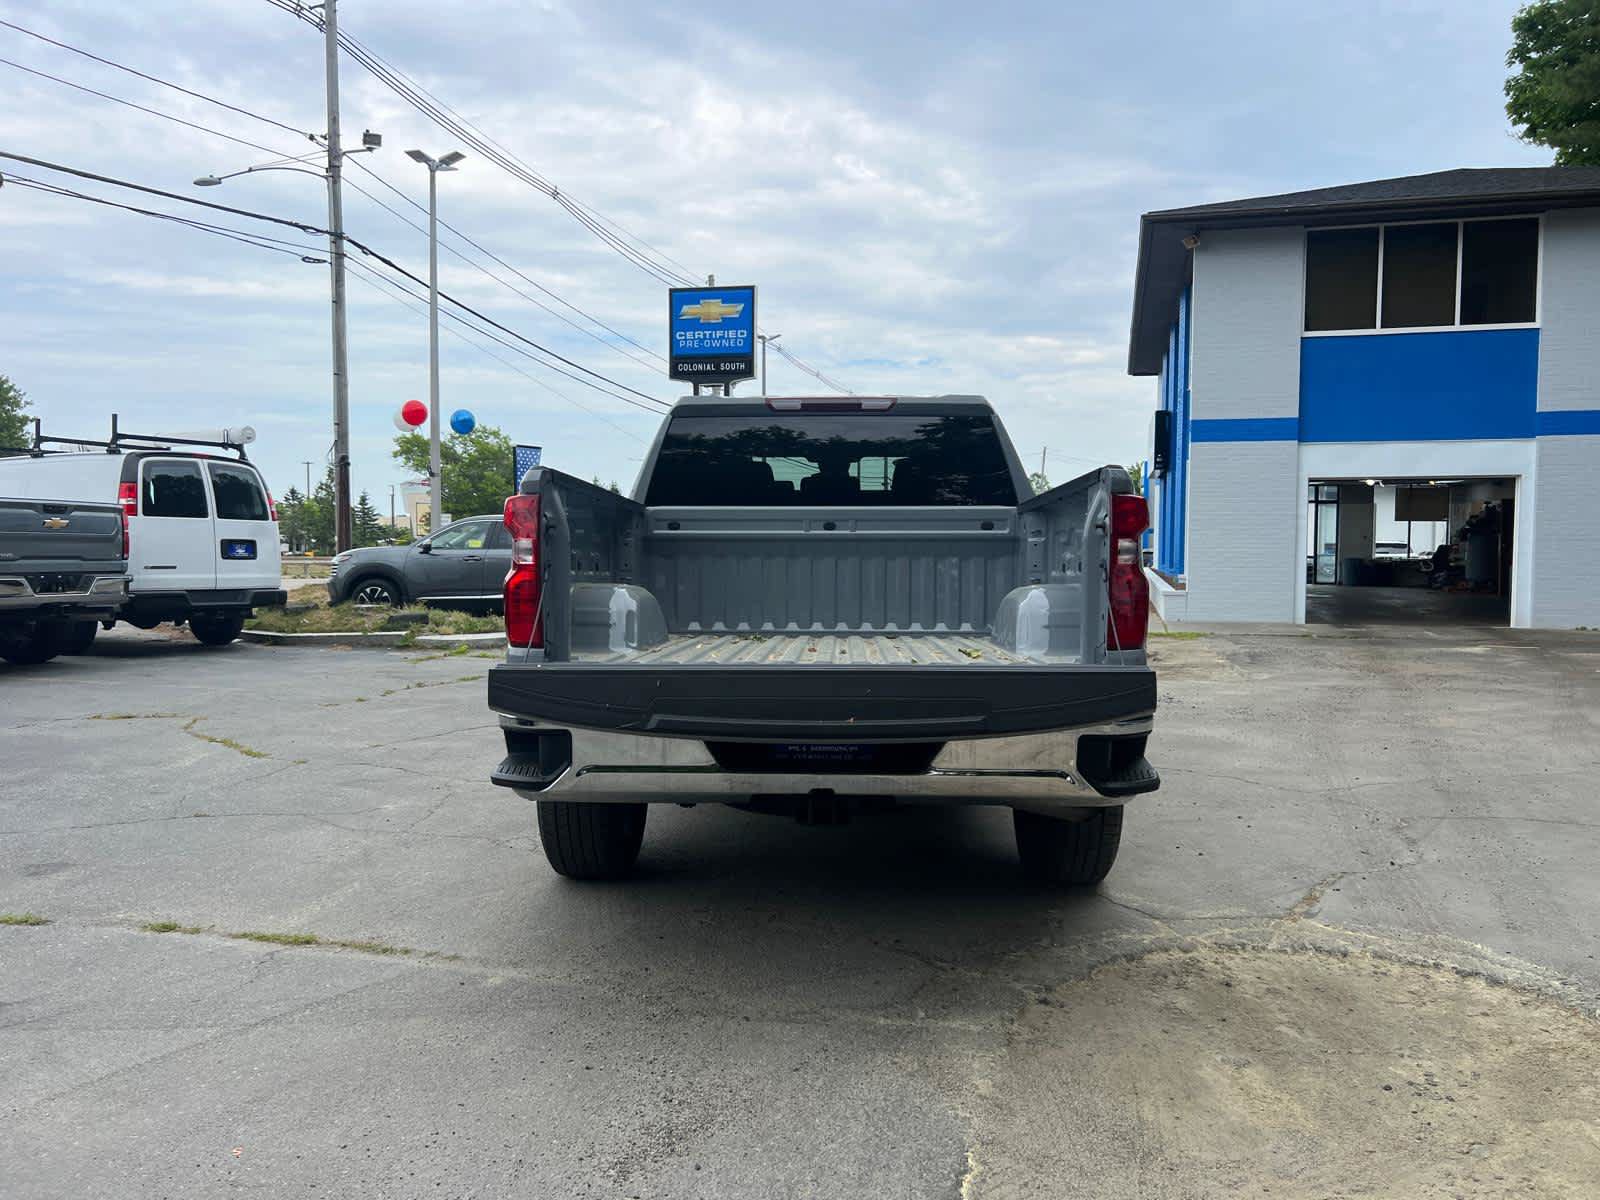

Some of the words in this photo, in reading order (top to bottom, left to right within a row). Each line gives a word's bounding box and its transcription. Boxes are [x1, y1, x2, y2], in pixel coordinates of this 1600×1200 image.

[676, 330, 747, 340] CERTIFIED
[680, 339, 744, 348] PRE-OWNED
[678, 362, 716, 371] COLONIAL
[720, 362, 744, 370] SOUTH
